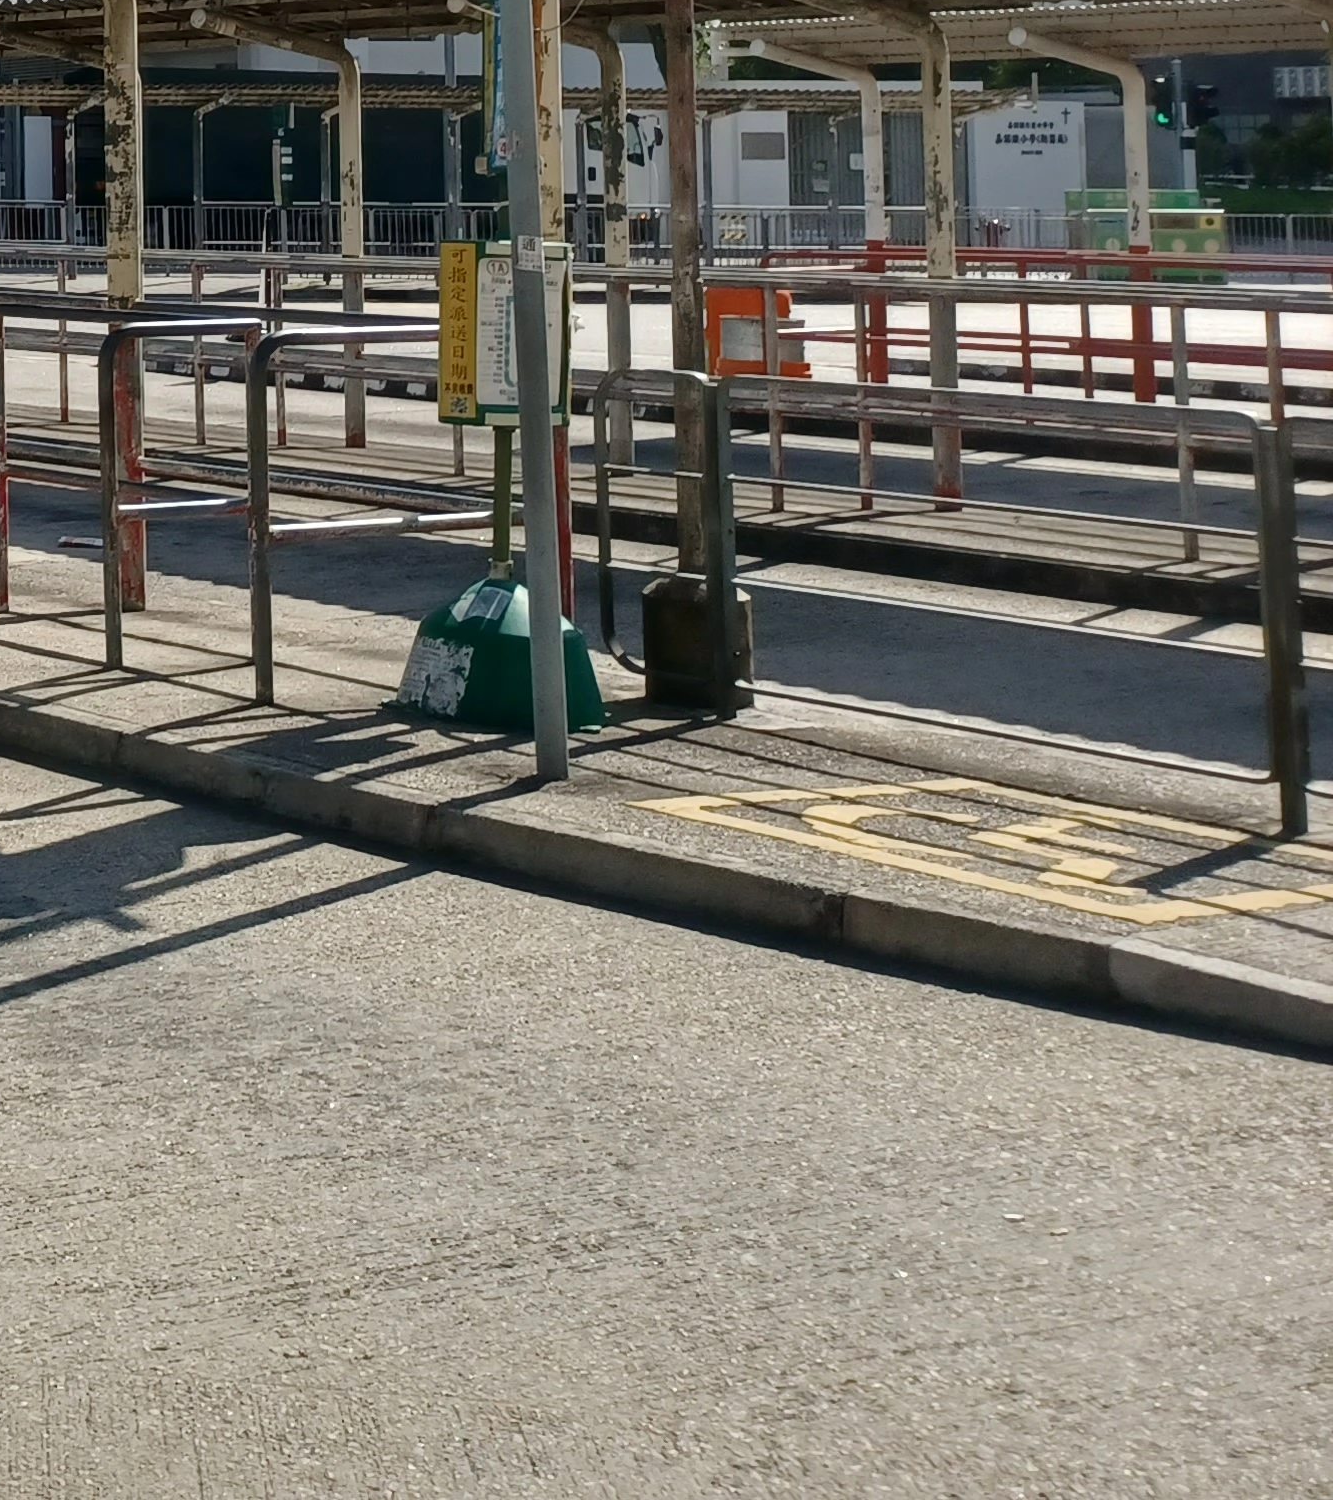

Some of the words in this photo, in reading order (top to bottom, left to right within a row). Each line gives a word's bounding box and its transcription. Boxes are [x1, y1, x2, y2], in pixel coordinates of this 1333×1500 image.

[490, 263, 505, 275] 1A
[448, 248, 469, 381] 可指定派送日期
